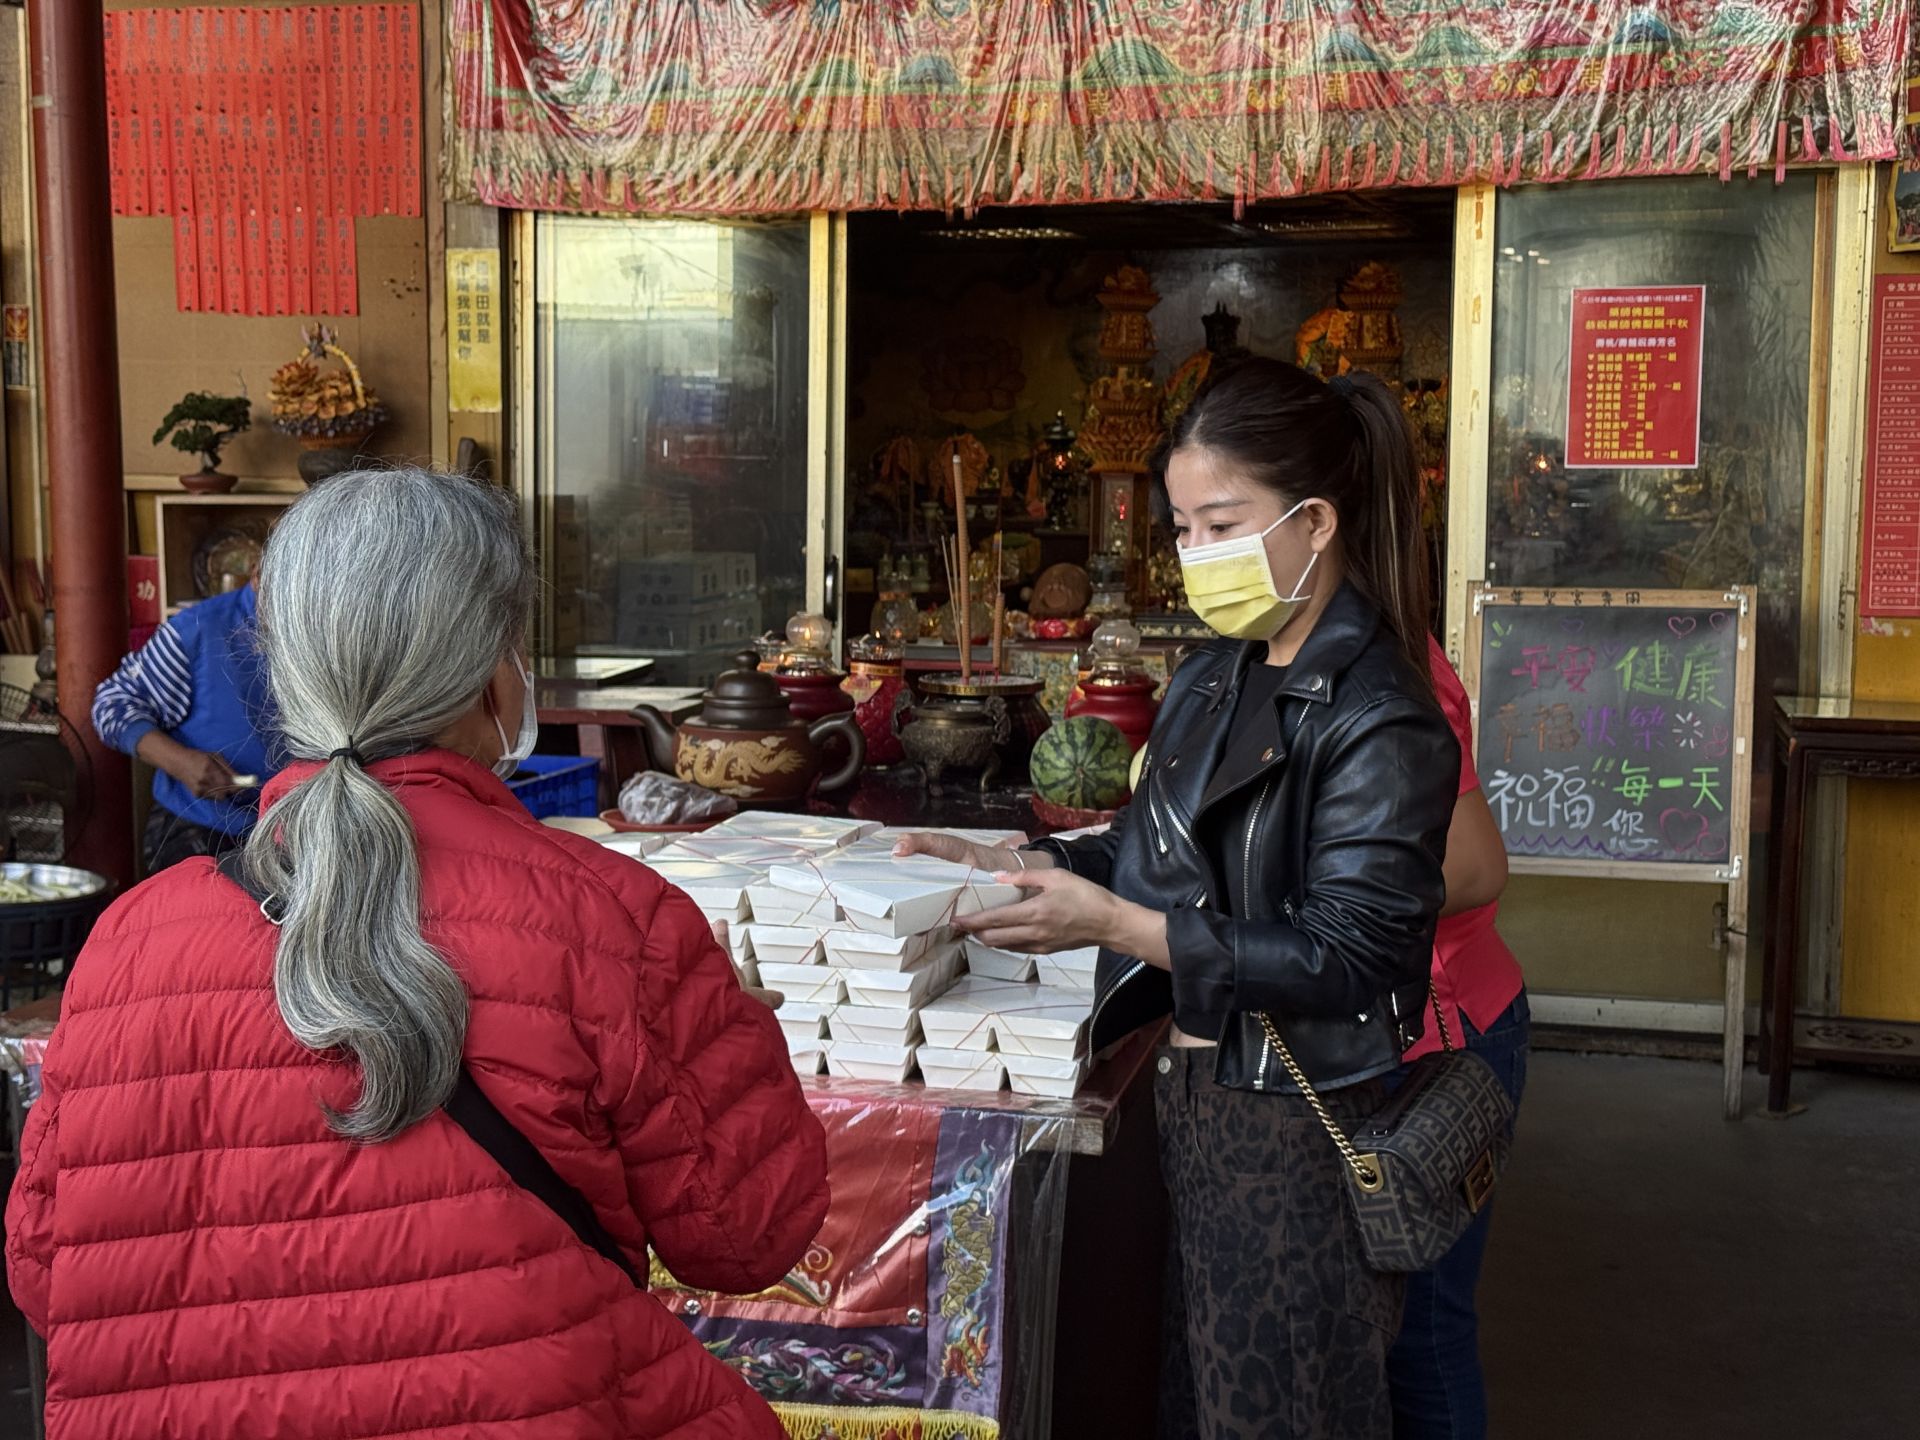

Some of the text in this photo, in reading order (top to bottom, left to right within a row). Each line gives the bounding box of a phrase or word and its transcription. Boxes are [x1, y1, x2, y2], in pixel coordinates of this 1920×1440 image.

[1511, 640, 1727, 710] 平安 健康
[1494, 702, 1666, 764] 幸福 快樂
[1487, 764, 1596, 832] 祝福
[1613, 758, 1724, 813] 每一天
[1602, 807, 1659, 853] 您
